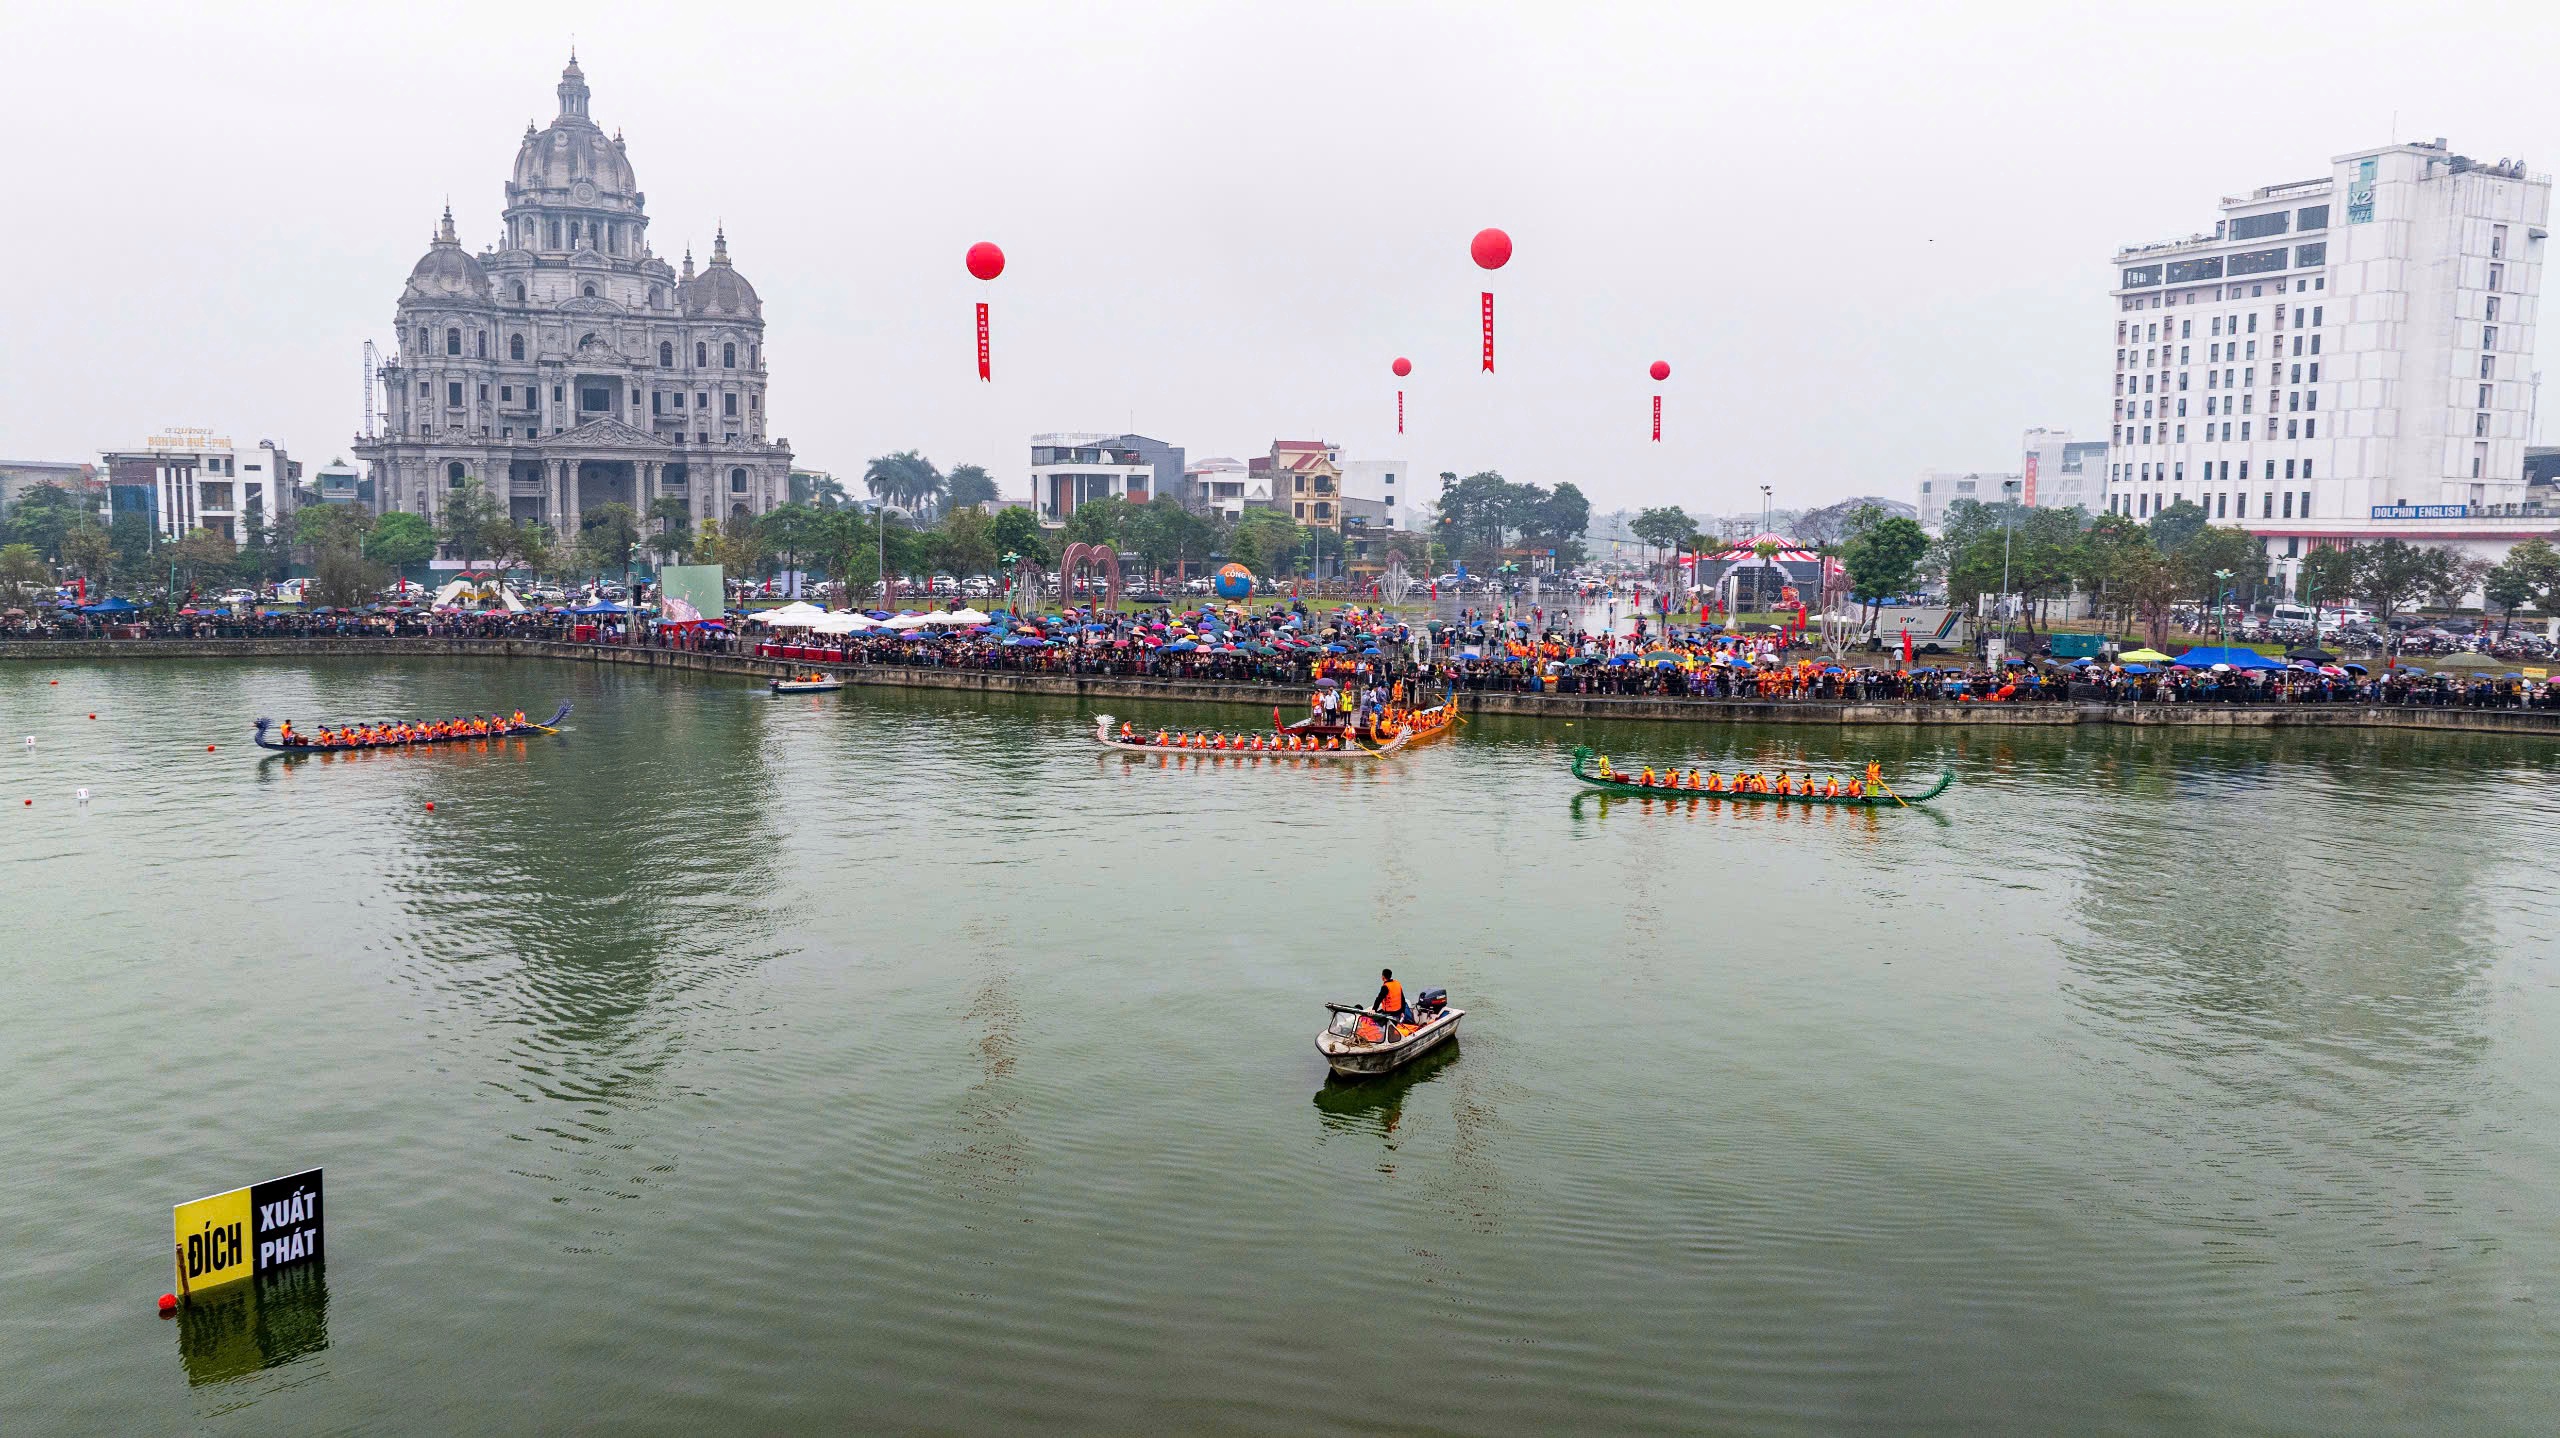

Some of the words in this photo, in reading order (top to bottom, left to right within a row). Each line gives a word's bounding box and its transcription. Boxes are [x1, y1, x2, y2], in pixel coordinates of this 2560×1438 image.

[2350, 191, 2374, 207] X2
[2374, 507, 2417, 519] DOLPHIN
[2418, 506, 2463, 518] ENGLISH
[260, 1185, 317, 1232] XUẤT
[187, 1220, 243, 1279] ĐÍCH
[260, 1227, 317, 1269] PHÁT
